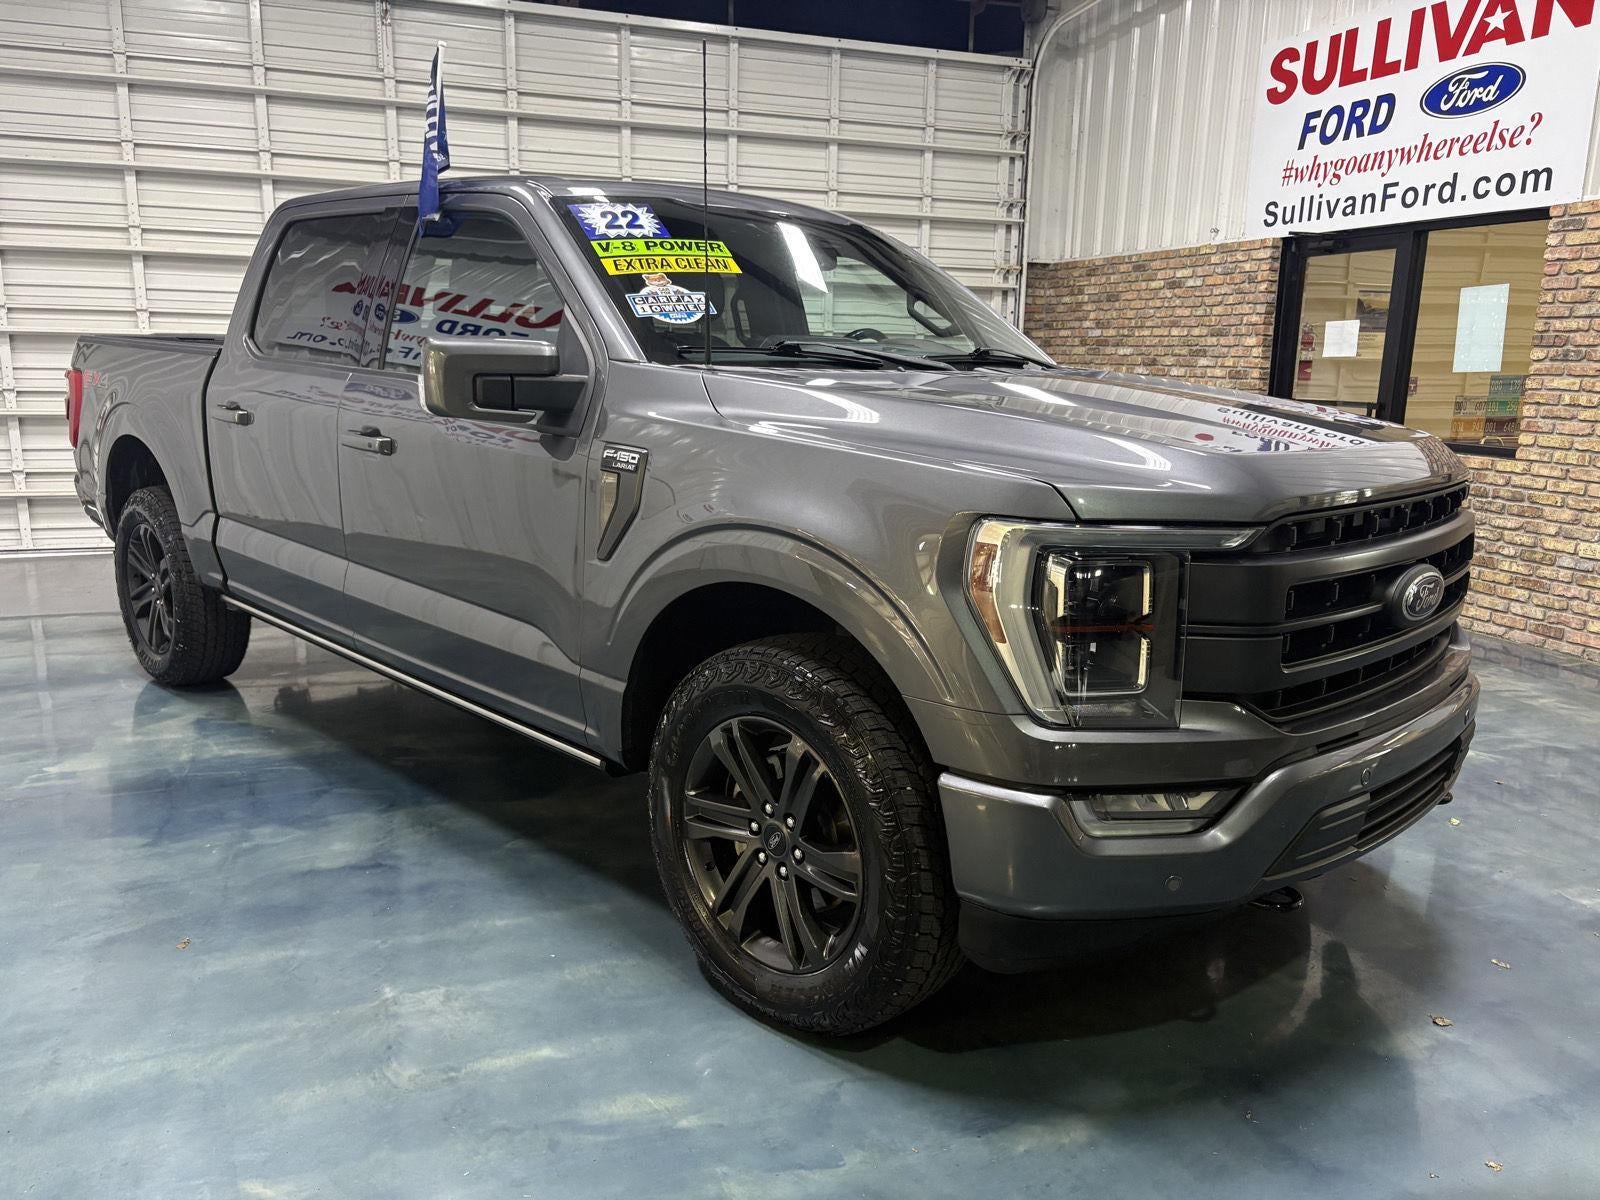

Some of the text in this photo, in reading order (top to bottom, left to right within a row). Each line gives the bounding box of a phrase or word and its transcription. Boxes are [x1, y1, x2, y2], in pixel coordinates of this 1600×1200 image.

[1266, 0, 1596, 105] SULLIVAN
[1439, 69, 1505, 113] Ford
[1297, 92, 1397, 151] FORD
[1281, 112, 1544, 189] #whygoanywhereelse?
[1262, 166, 1554, 229] SullivanFord.com
[600, 210, 645, 230] 22
[597, 240, 724, 253] V-8 POWER
[613, 257, 730, 272] EXTRA CLEAN
[632, 295, 706, 304] CARFAX
[650, 304, 706, 312] OWNER
[603, 448, 641, 464] F-150
[612, 461, 636, 471] LARIAT
